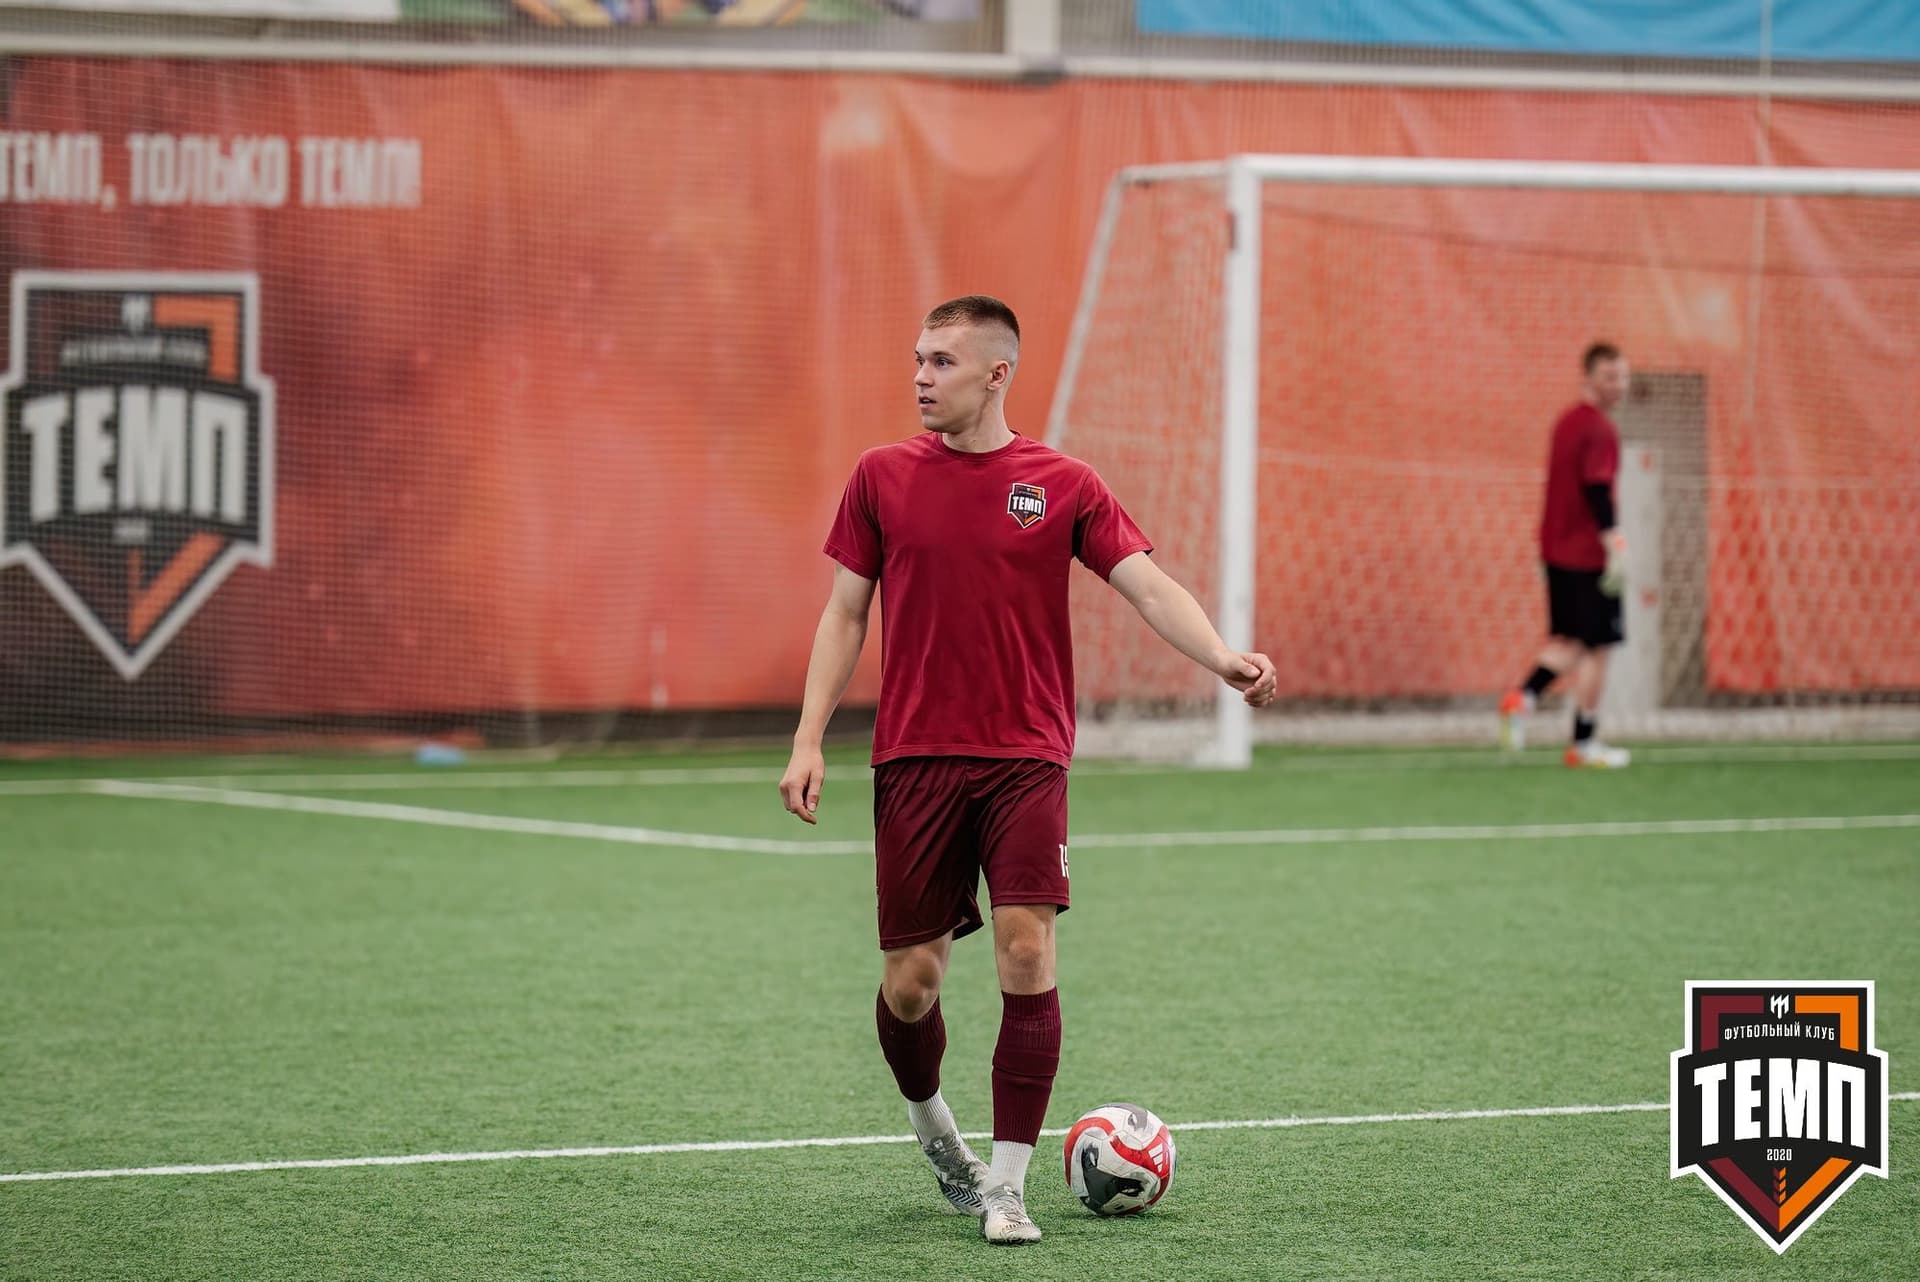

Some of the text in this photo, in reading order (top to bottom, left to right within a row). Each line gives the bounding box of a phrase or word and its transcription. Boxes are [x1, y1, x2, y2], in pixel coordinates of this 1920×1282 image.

[126, 132, 290, 206] ТОЛЬКО
[22, 384, 248, 525] ТЕМП
[1012, 496, 1042, 514] ТЕМП
